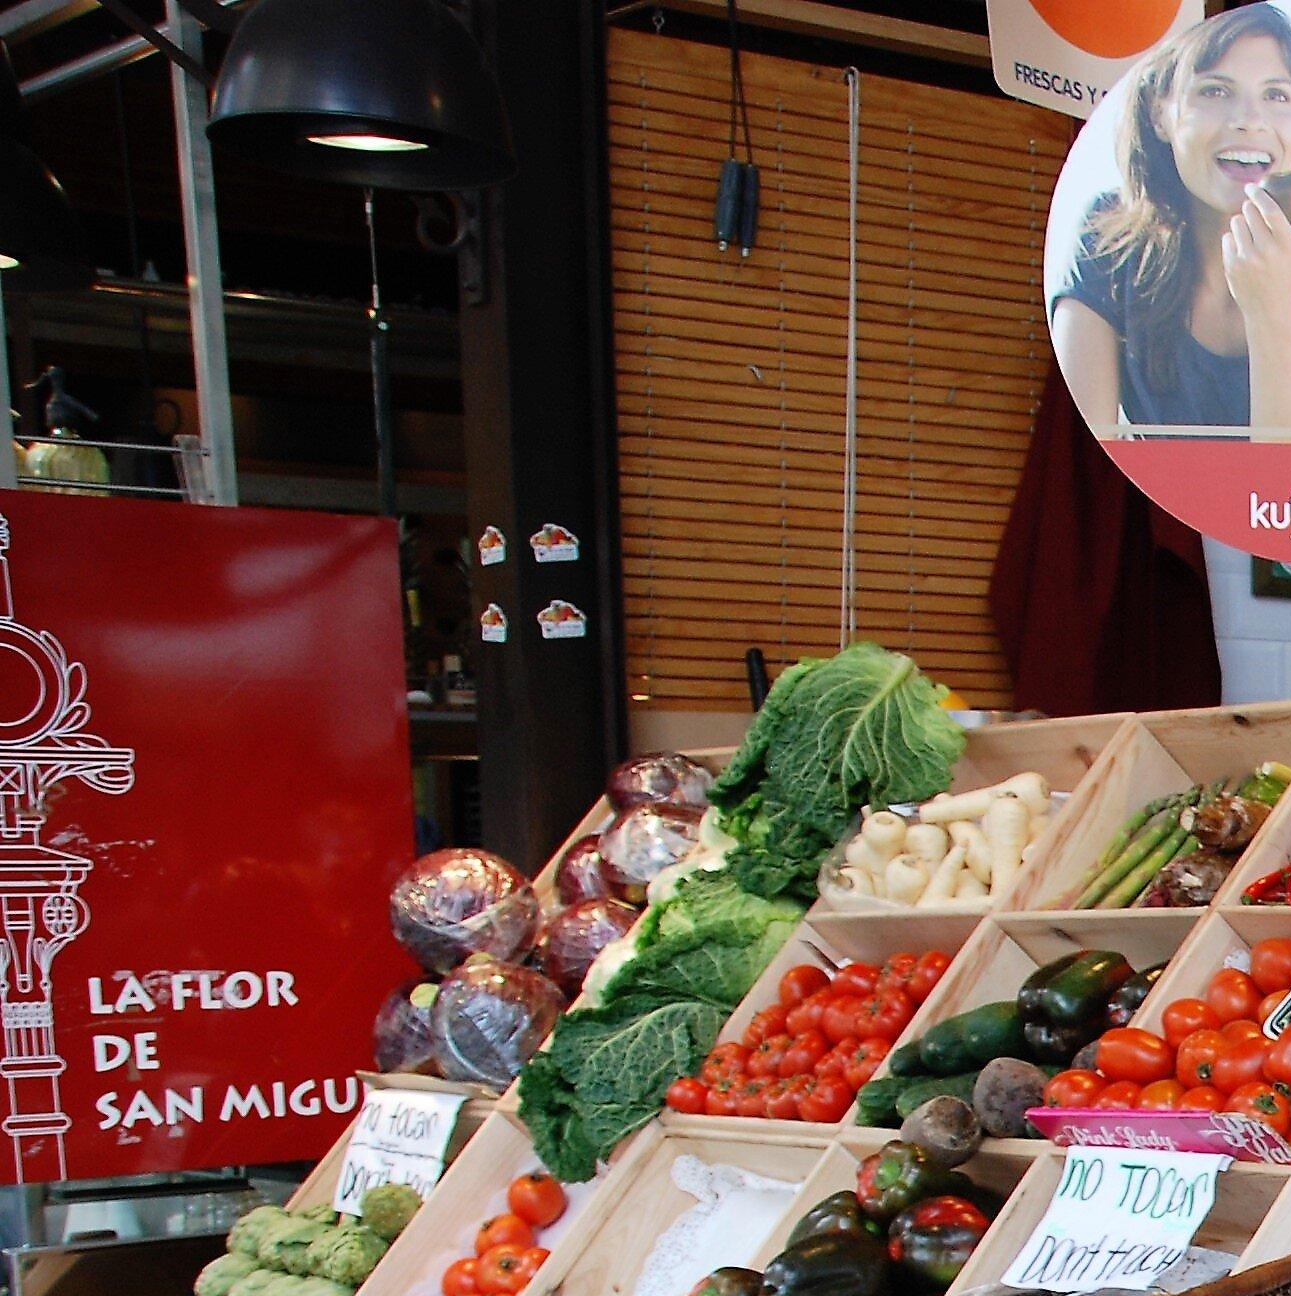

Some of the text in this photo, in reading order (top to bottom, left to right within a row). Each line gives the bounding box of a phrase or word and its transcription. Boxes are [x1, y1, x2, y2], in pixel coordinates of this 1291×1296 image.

[1014, 62, 1097, 104] FRESCAS Y
[88, 969, 299, 1015] LA FLOR
[93, 1031, 160, 1072] DE
[94, 1086, 204, 1131] SAN
[1115, 1125, 1178, 1151] Lady
